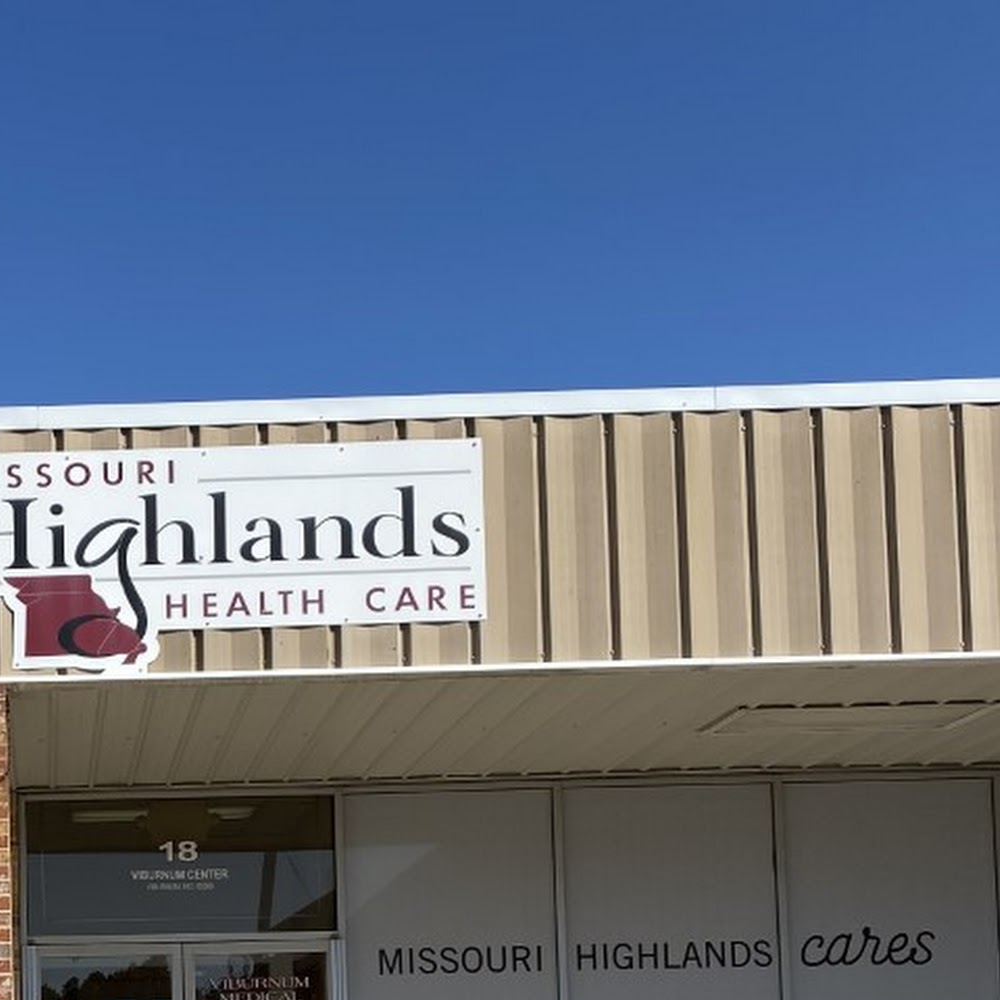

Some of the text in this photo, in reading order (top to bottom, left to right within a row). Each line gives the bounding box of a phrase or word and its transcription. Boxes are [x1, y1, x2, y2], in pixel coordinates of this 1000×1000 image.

[165, 584, 476, 619] HEALTH CARE
[158, 839, 199, 862] 18
[186, 868, 230, 880] CENTER
[378, 926, 936, 976] MISSOURI HIGHLANDS cares
[209, 976, 310, 991] VIBURNUM
